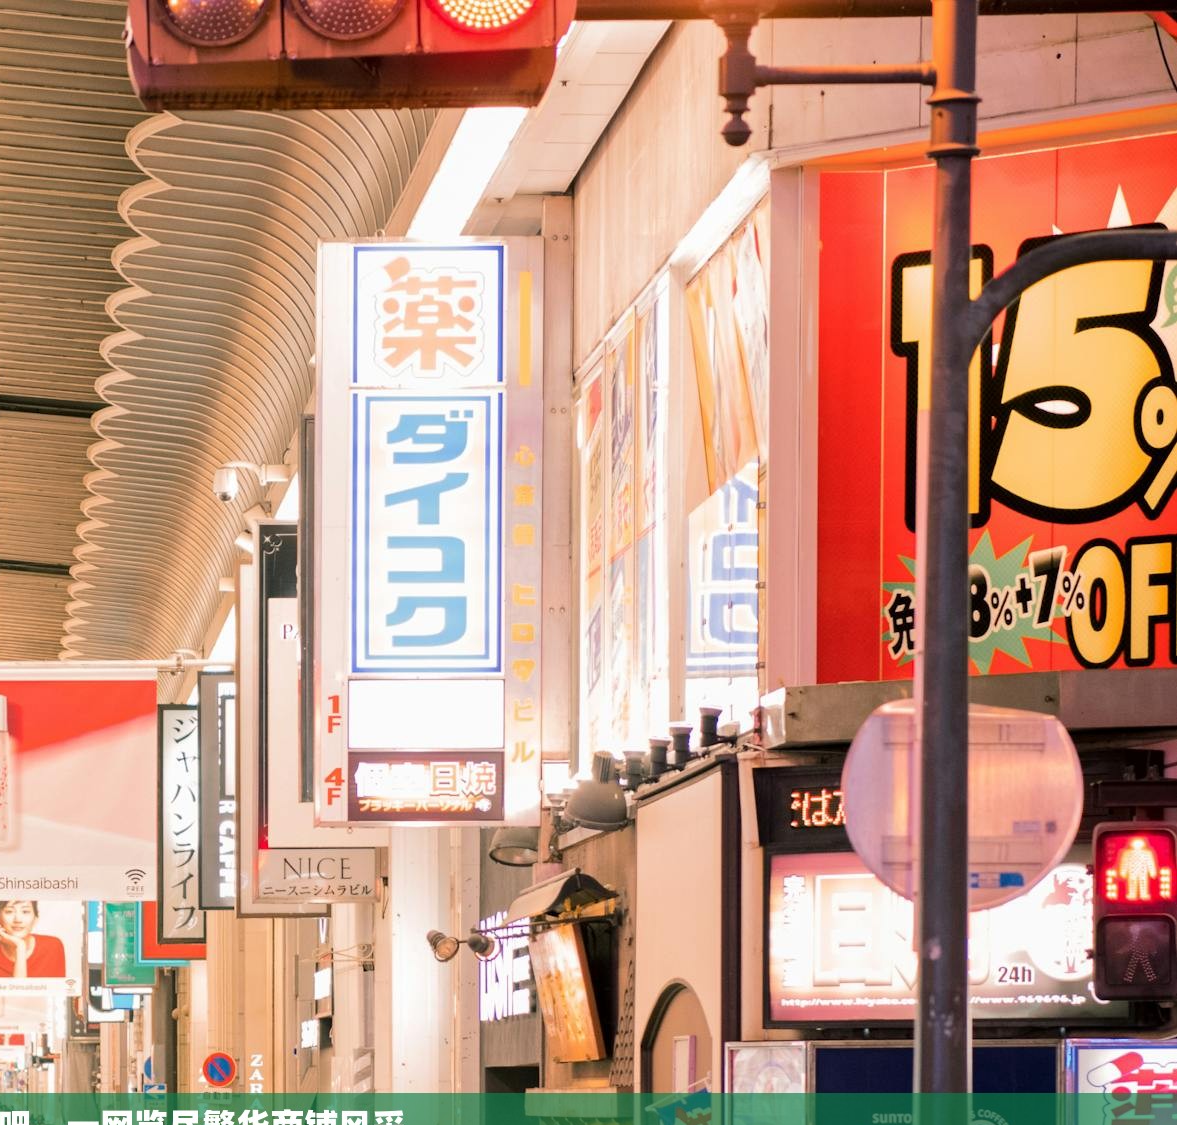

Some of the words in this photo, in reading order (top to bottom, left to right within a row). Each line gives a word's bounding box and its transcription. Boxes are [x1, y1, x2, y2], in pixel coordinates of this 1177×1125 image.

[380, 256, 478, 371] 薬
[383, 408, 475, 648] ダイコク
[281, 623, 300, 640] P
[327, 694, 342, 734] 1F
[324, 766, 345, 805] 4F
[171, 715, 197, 929] ジャハンライフ
[282, 857, 353, 880] NICE
[262, 883, 373, 897] ニースニシムラビル
[997, 966, 1033, 983] 24h
[249, 1054, 264, 1110] ZARA
